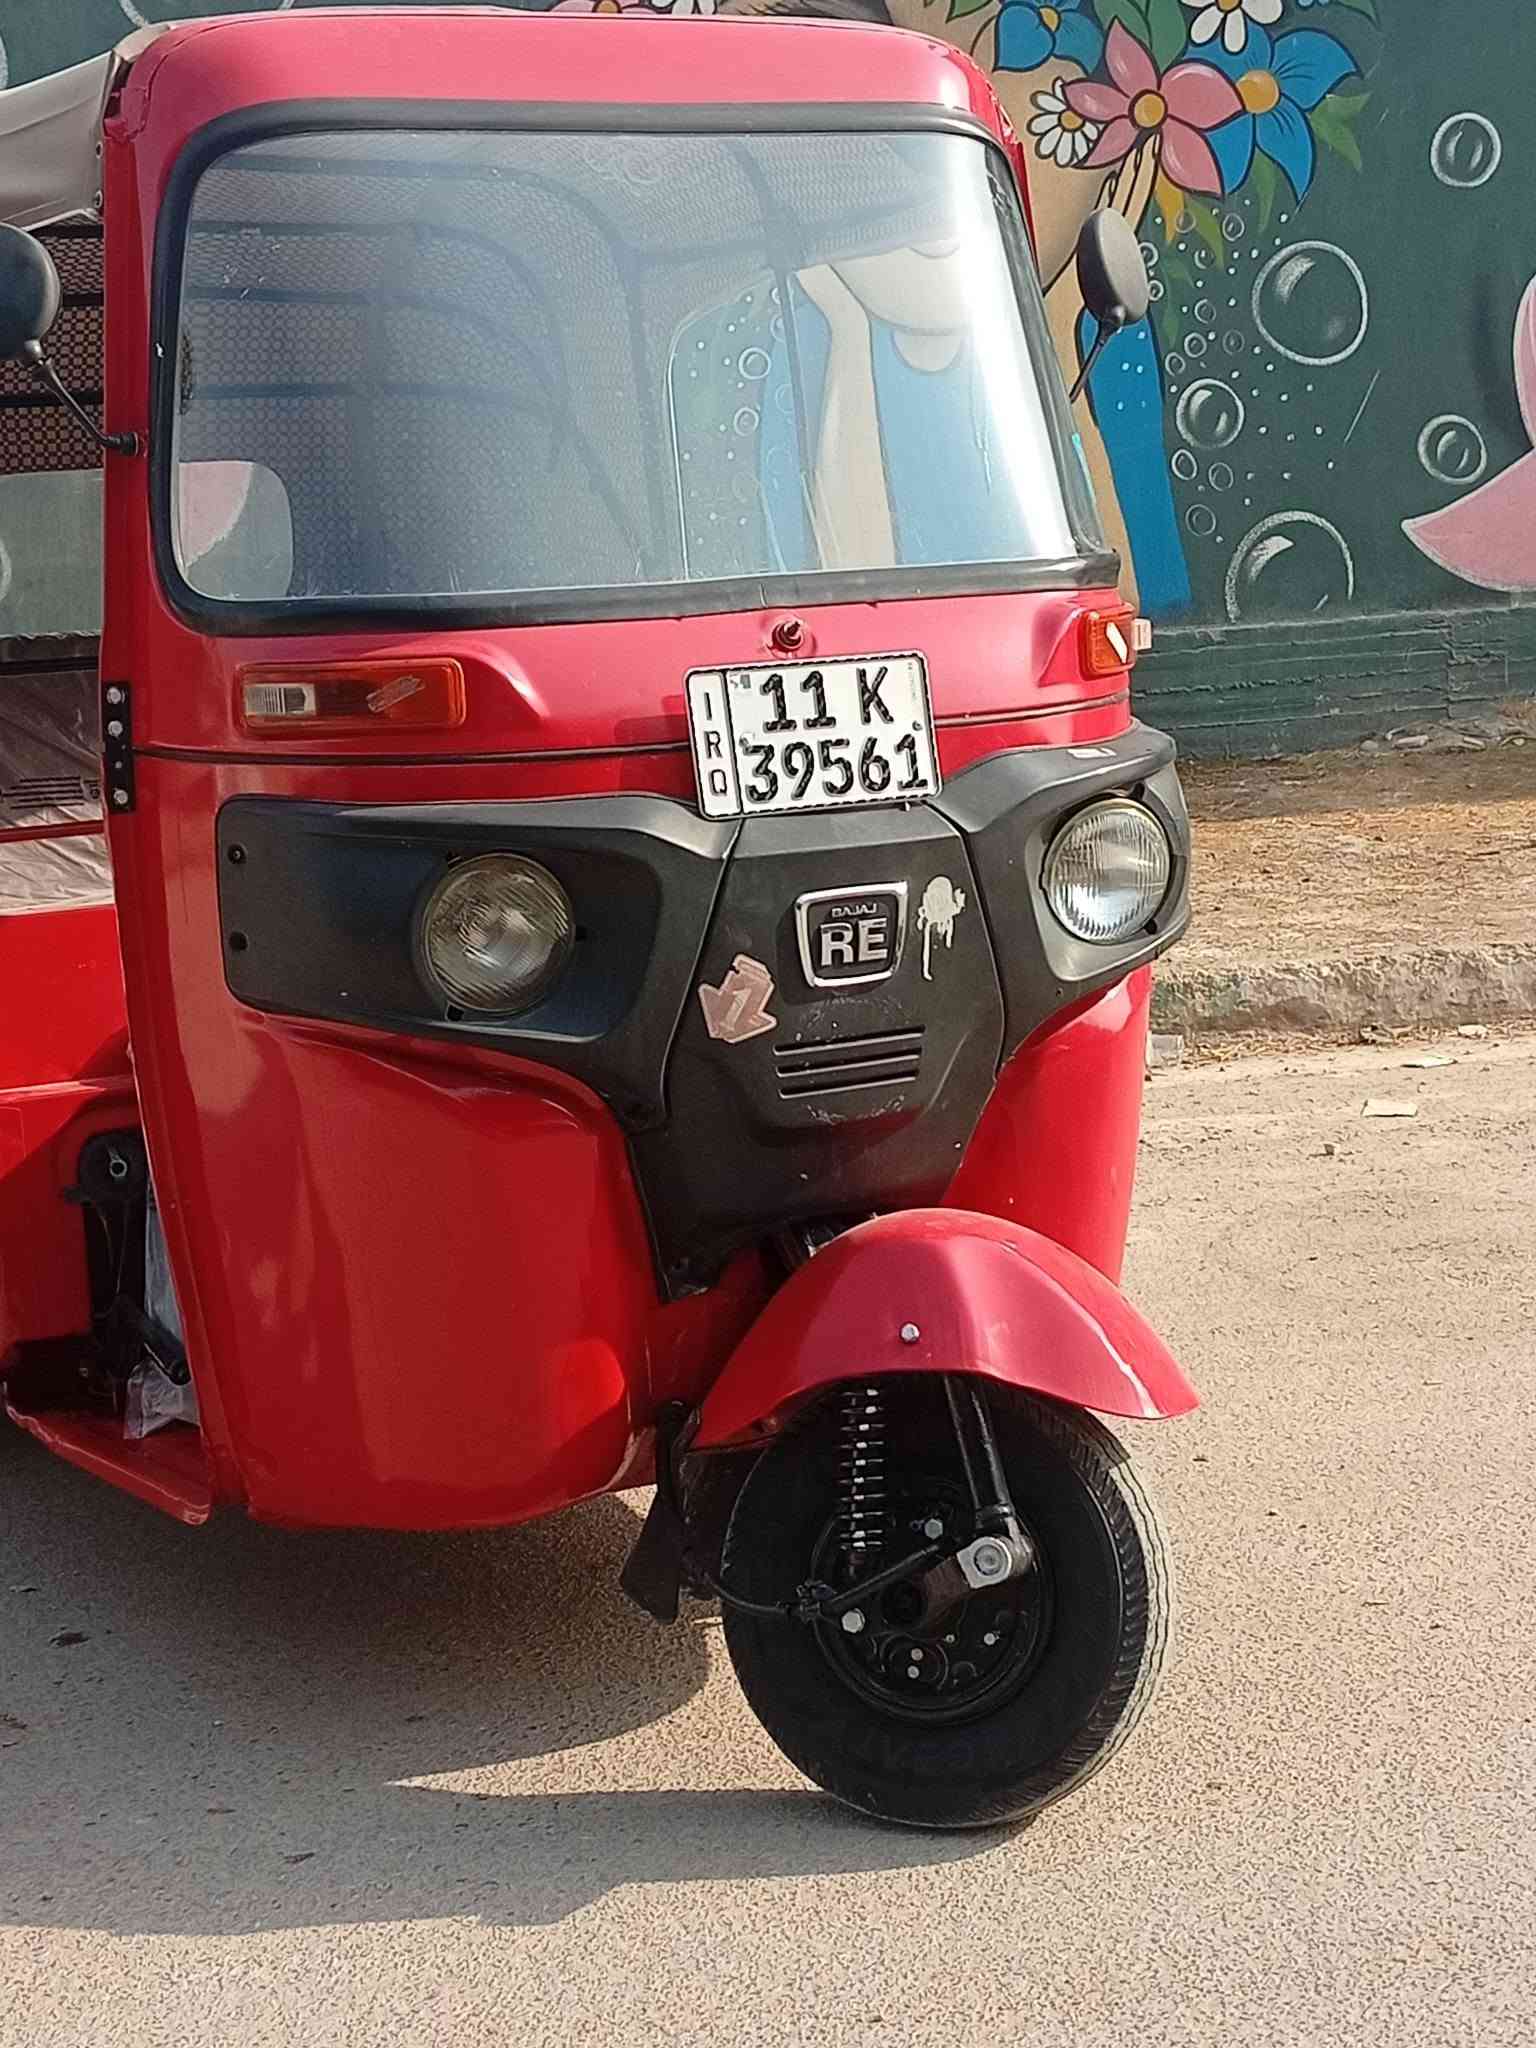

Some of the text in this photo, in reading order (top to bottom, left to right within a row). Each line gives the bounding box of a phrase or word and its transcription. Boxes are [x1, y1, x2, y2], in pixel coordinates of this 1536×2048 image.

[760, 670, 837, 733] 11
[856, 666, 895, 726] K
[703, 692, 728, 797] IRQ
[740, 733, 929, 804] 39561
[820, 917, 889, 967] RE
[831, 903, 877, 918] BAJAJ
